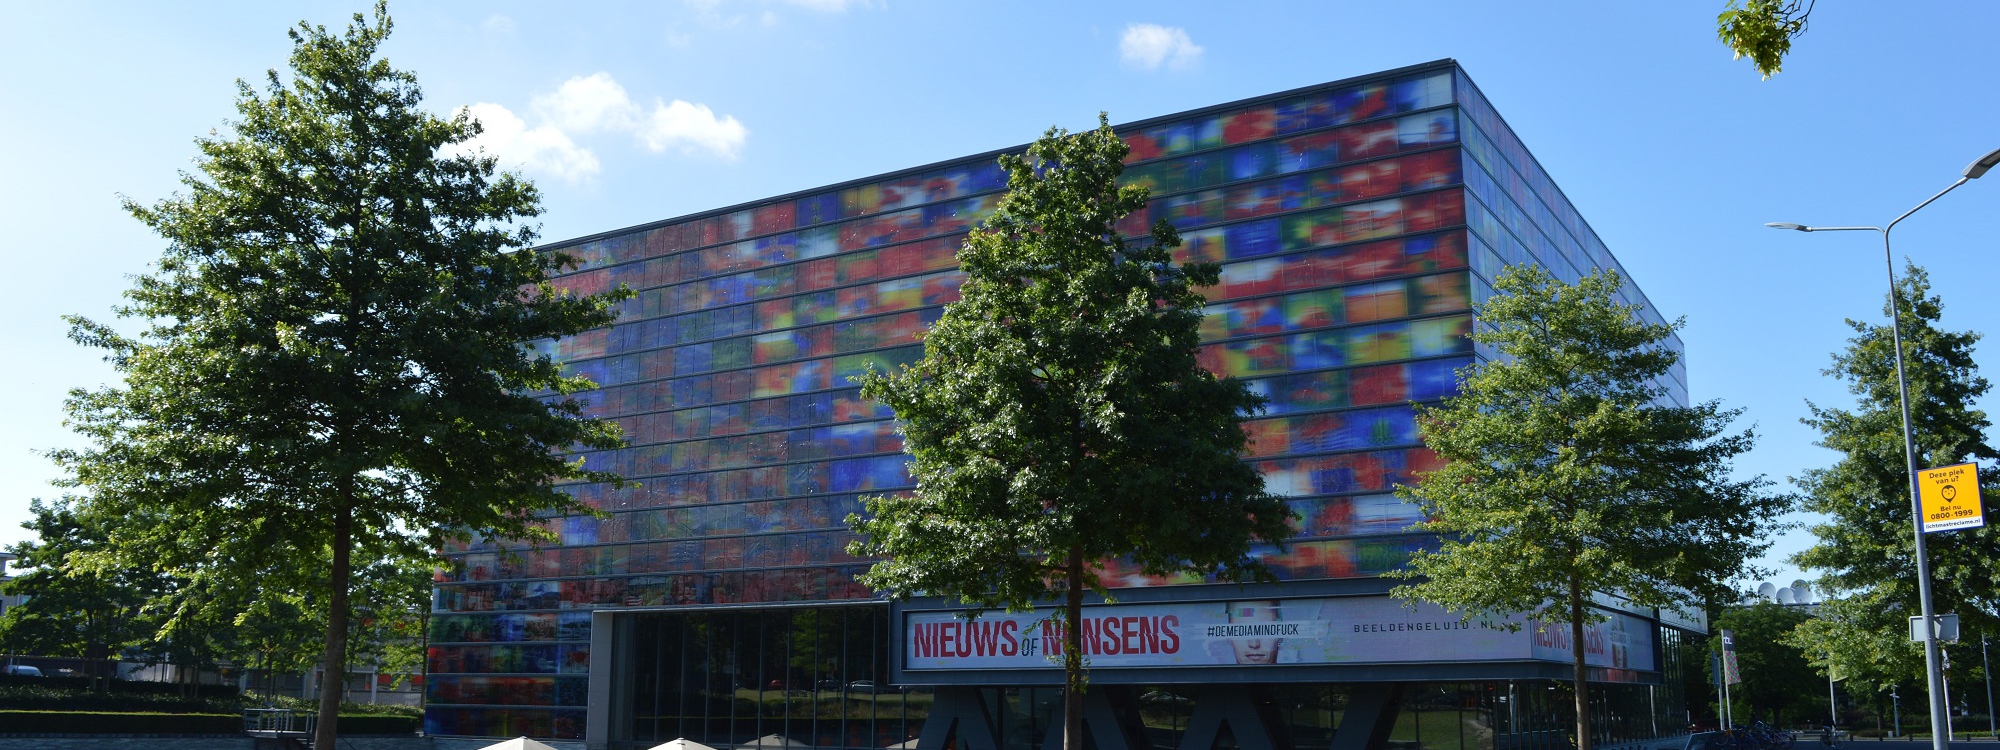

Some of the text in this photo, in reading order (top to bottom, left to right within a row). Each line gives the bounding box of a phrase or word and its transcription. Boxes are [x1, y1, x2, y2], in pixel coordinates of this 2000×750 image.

[1949, 469, 1964, 477] plek
[1926, 519, 1980, 529] lichtmastreclame.nl
[1207, 623, 1299, 638] #DEMEDIAMINDFUCK
[914, 619, 1019, 658] NIEUWS
[1021, 637, 1039, 657] OF
